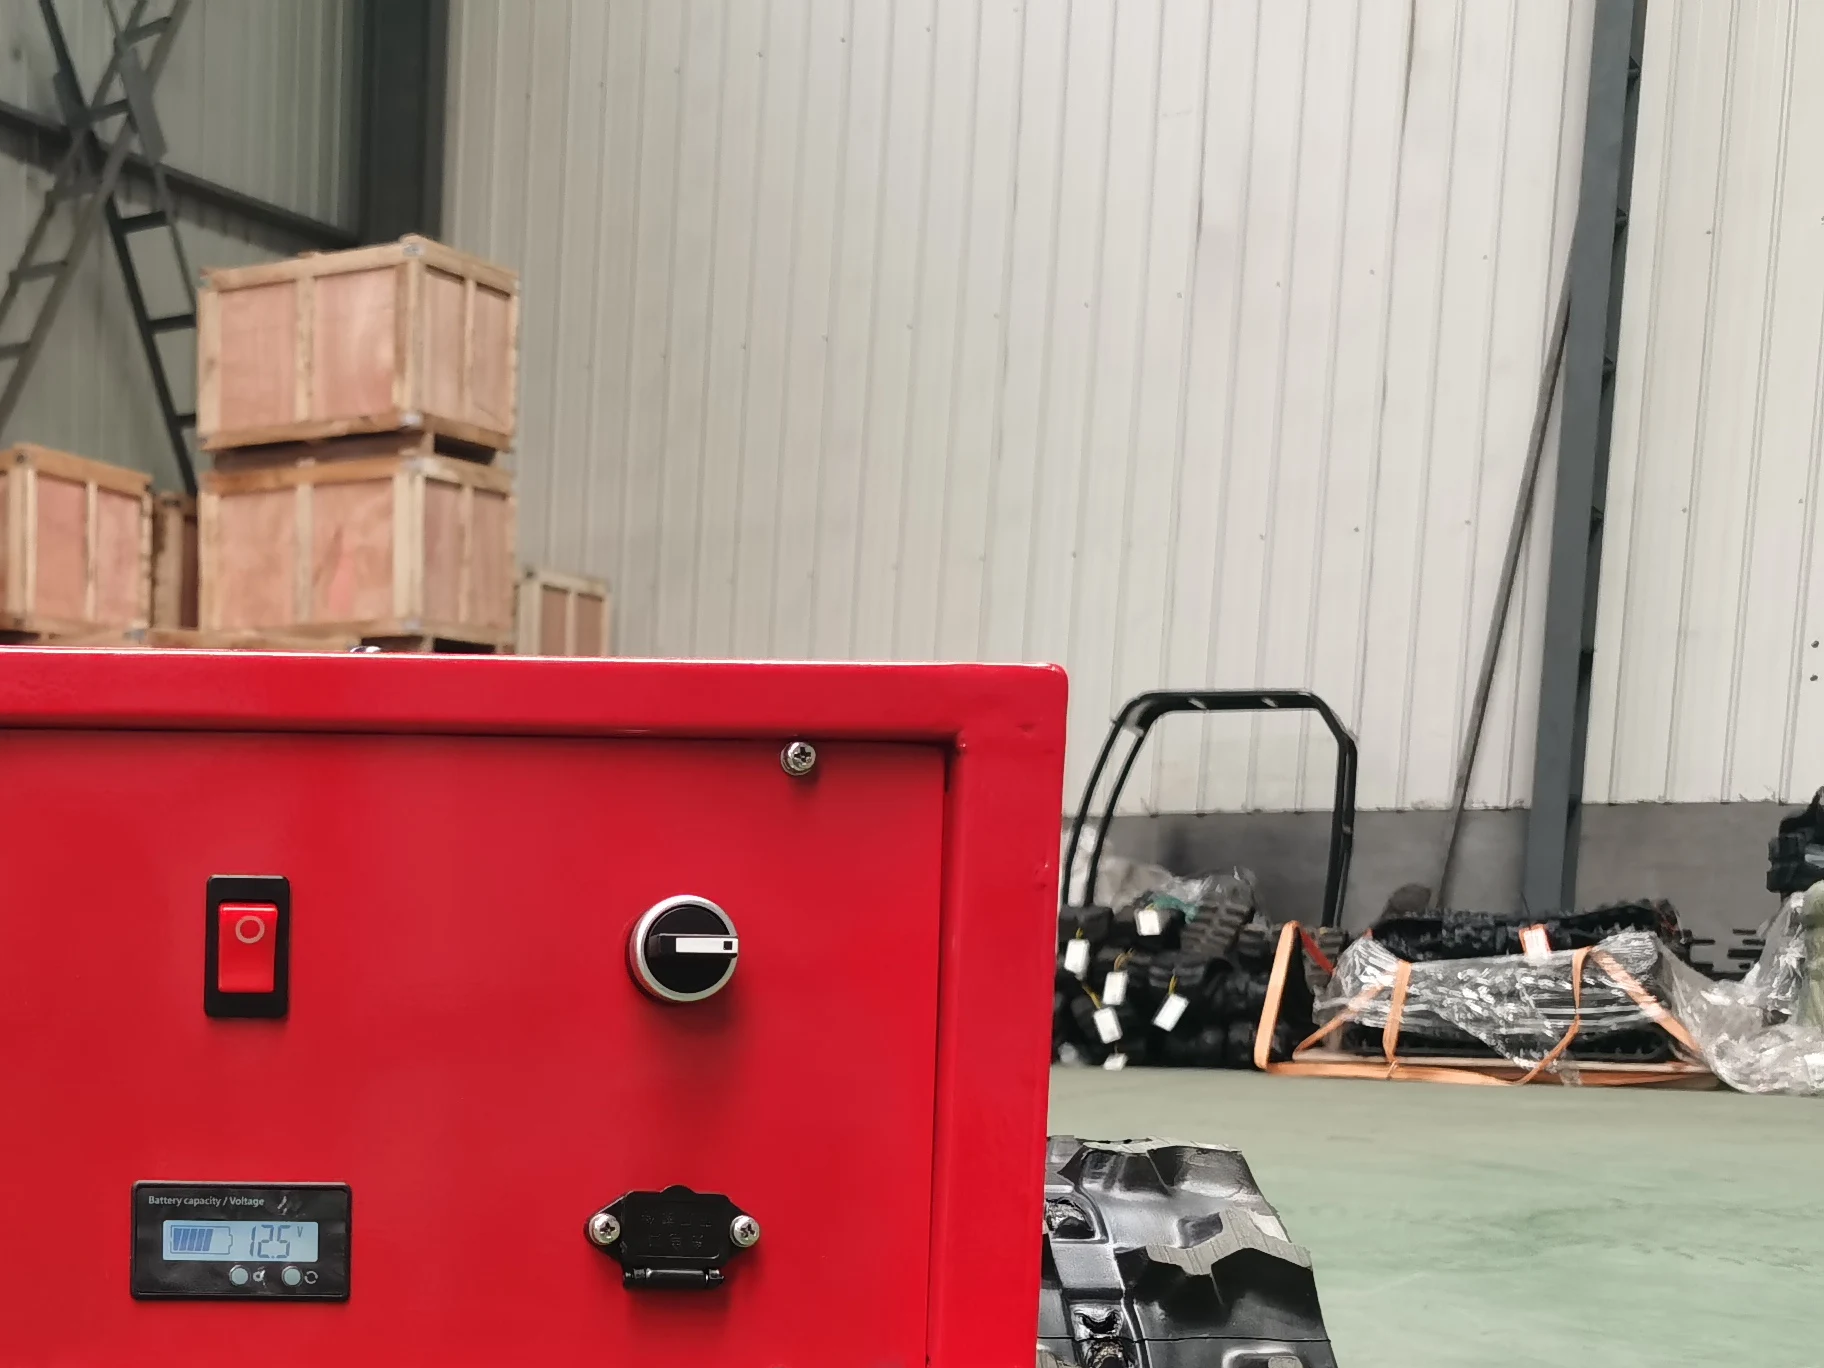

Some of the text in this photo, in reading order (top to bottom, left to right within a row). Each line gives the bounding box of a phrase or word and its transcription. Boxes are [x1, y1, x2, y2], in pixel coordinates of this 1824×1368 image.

[148, 1195, 182, 1207] Battery
[183, 1196, 222, 1208] capacity
[229, 1196, 265, 1208] Voltage
[249, 1224, 291, 1259] 12.5
